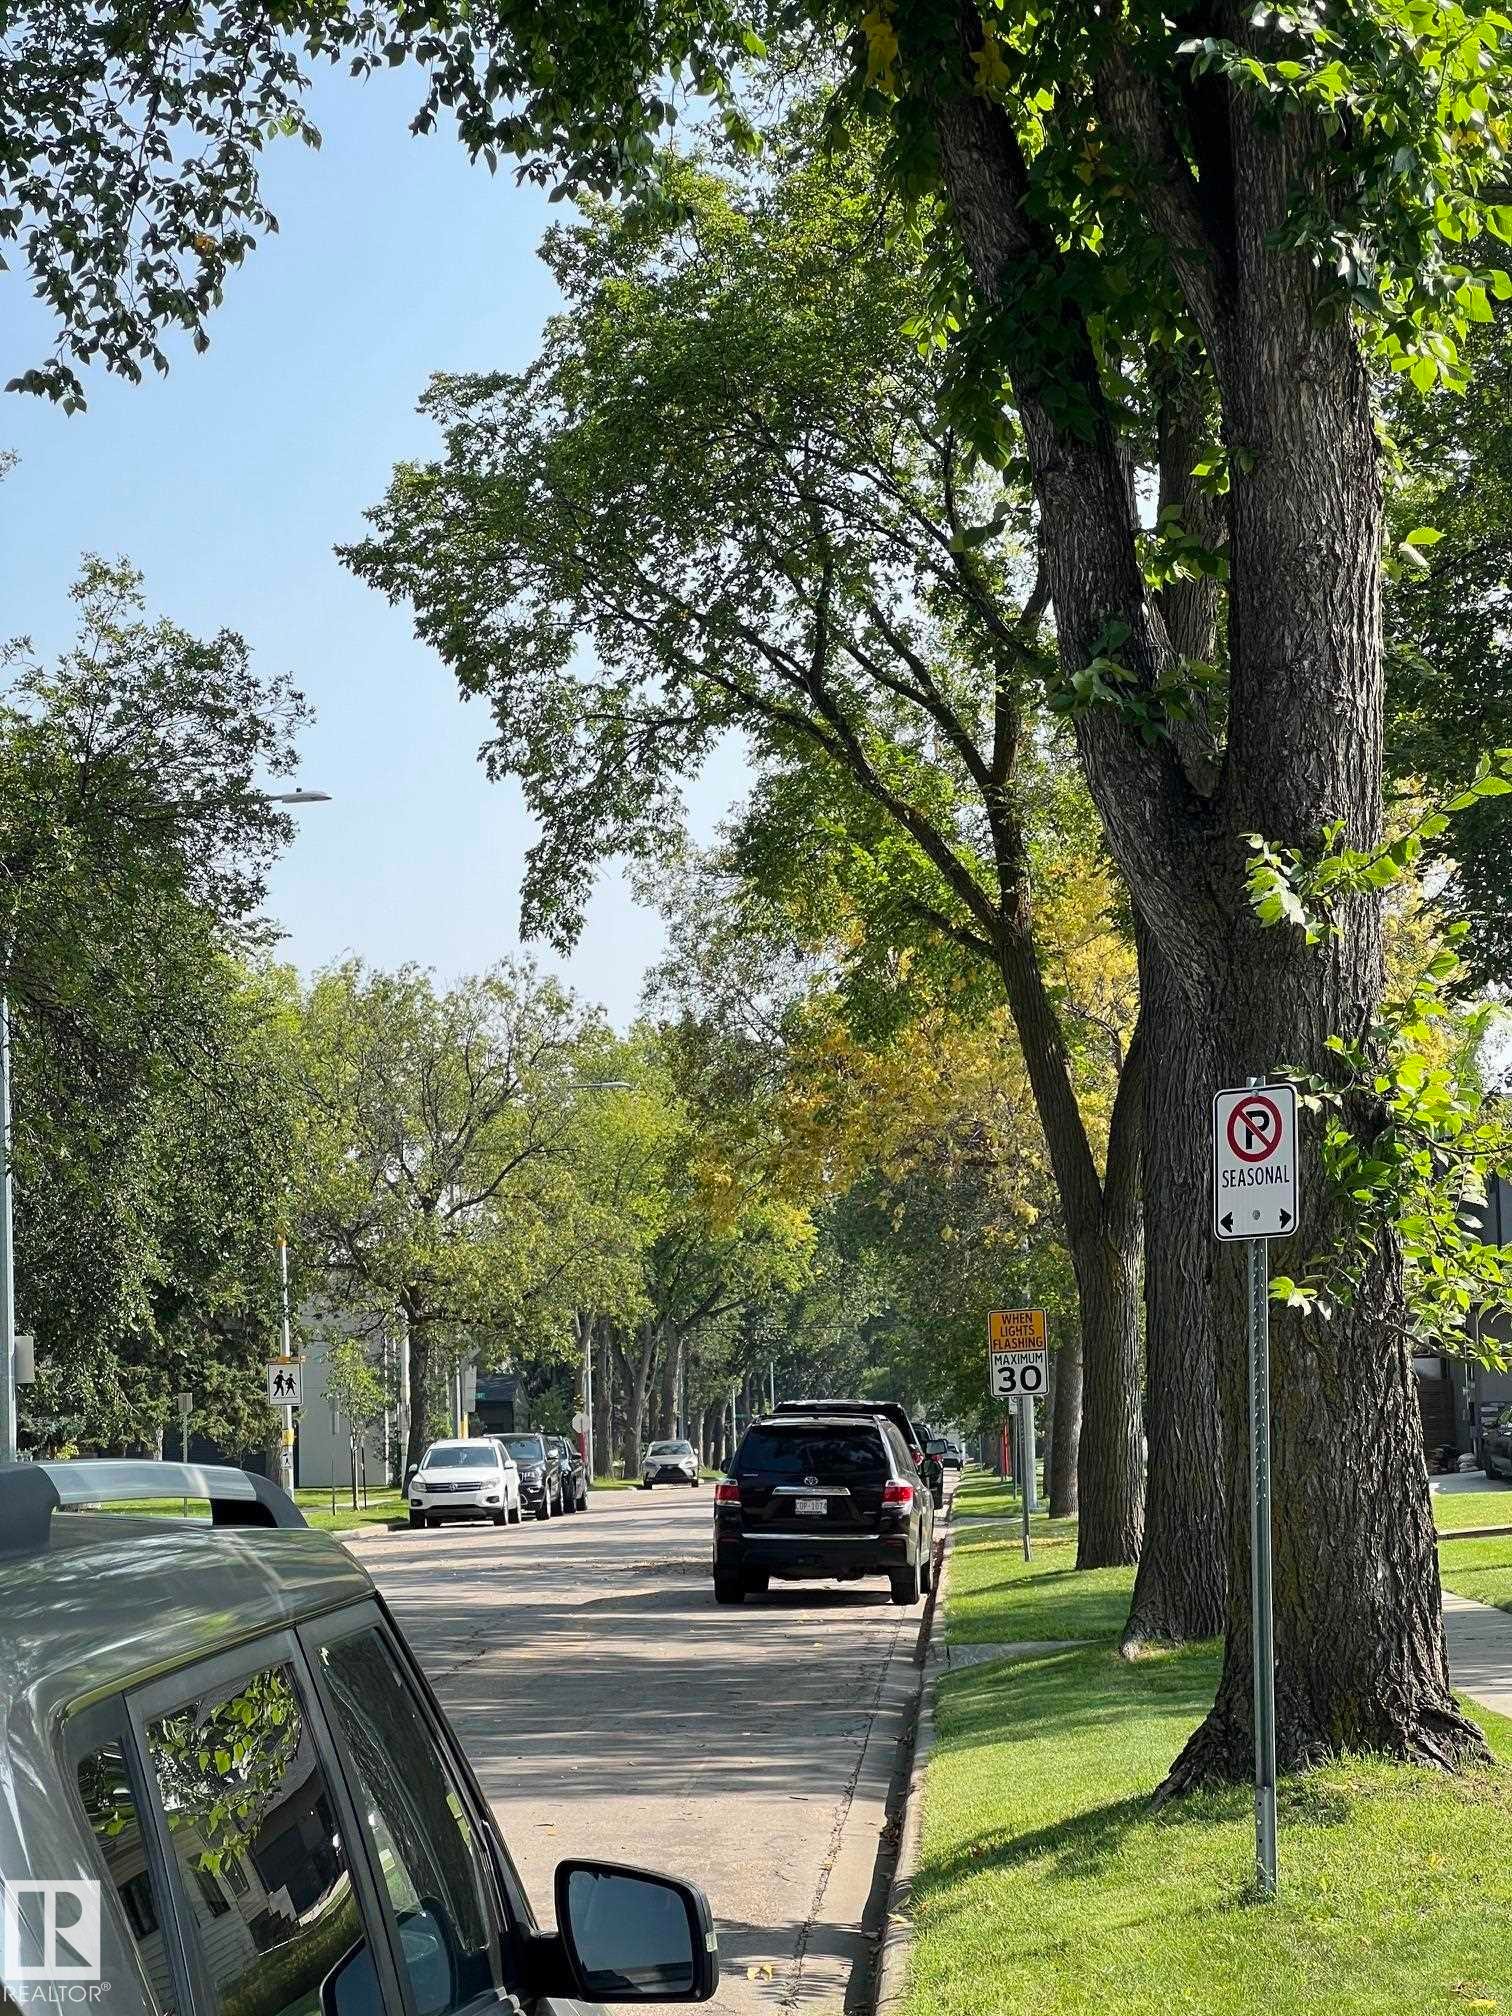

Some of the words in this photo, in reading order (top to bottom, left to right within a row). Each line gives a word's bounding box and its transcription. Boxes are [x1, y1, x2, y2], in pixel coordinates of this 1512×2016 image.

[1222, 1165, 1290, 1188] SEASONAL
[1001, 1313, 1033, 1325] WHEN
[1000, 1325, 1035, 1337] LIGHTS
[993, 1337, 1043, 1350] FLASHING
[994, 1353, 1043, 1365] MAXIMUM
[998, 1365, 1042, 1392] 30
